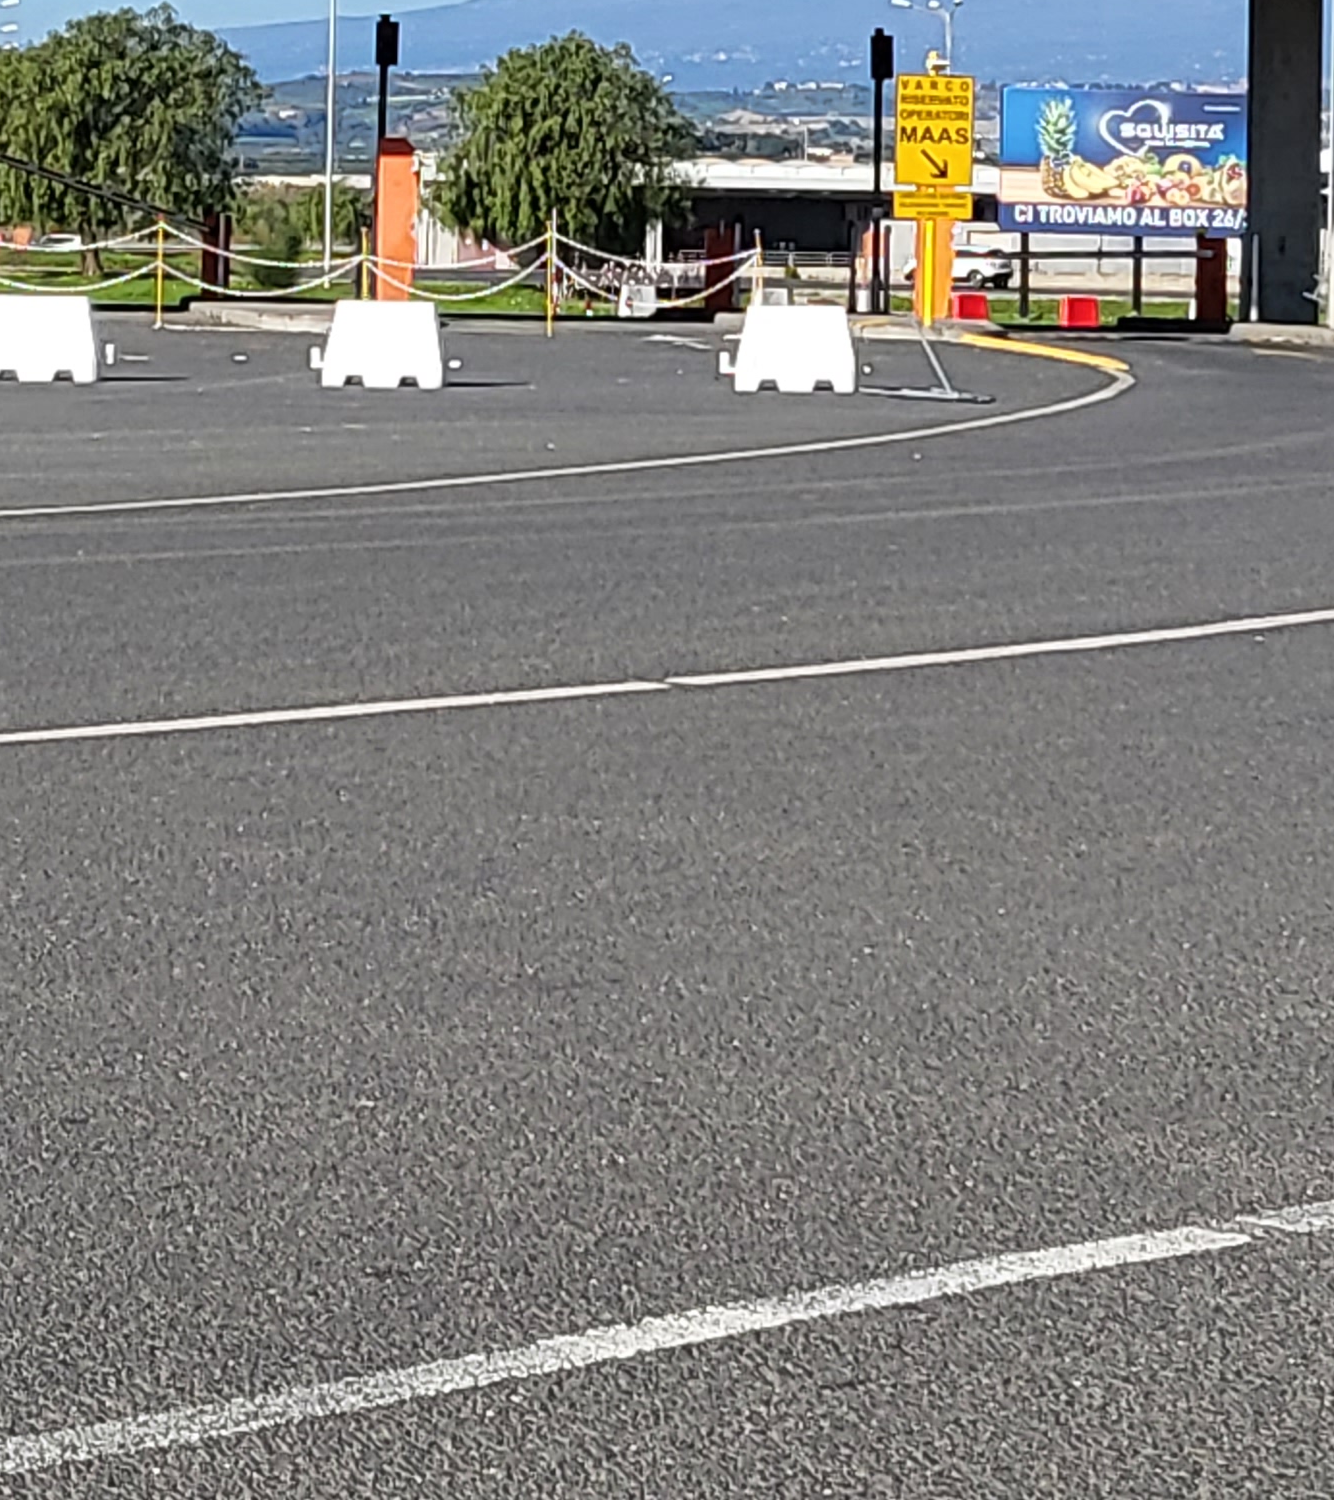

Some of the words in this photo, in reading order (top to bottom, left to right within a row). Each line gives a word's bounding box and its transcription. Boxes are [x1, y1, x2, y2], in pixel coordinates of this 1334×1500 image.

[899, 126, 970, 144] MAAS
[1014, 205, 1034, 224] CI
[1036, 205, 1137, 226] TROVIAMO
[1140, 207, 1167, 226] AL
[1169, 208, 1209, 227] BOX
